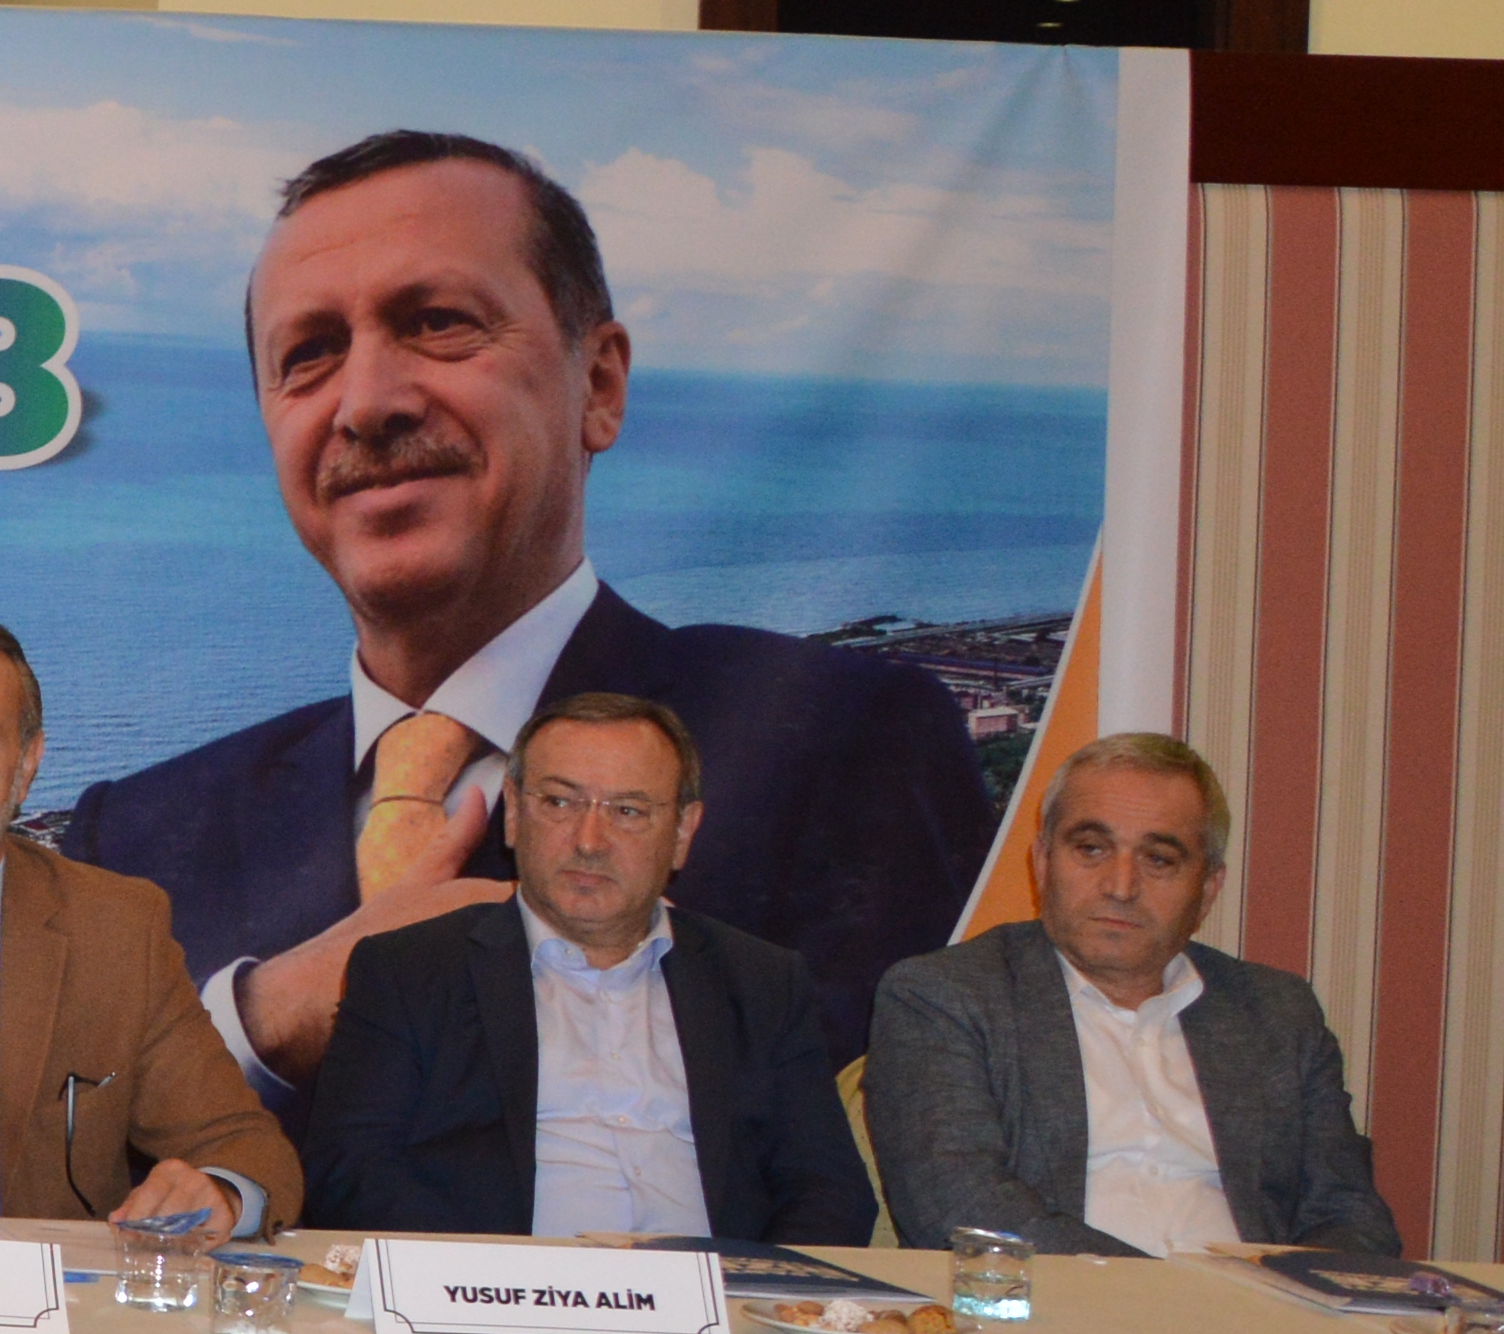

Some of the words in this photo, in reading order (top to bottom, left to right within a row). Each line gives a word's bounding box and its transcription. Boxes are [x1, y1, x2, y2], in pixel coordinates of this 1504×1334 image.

[443, 1285, 527, 1306] YUSUF
[531, 1285, 590, 1309] ZİYA
[594, 1288, 656, 1312] ALİM
